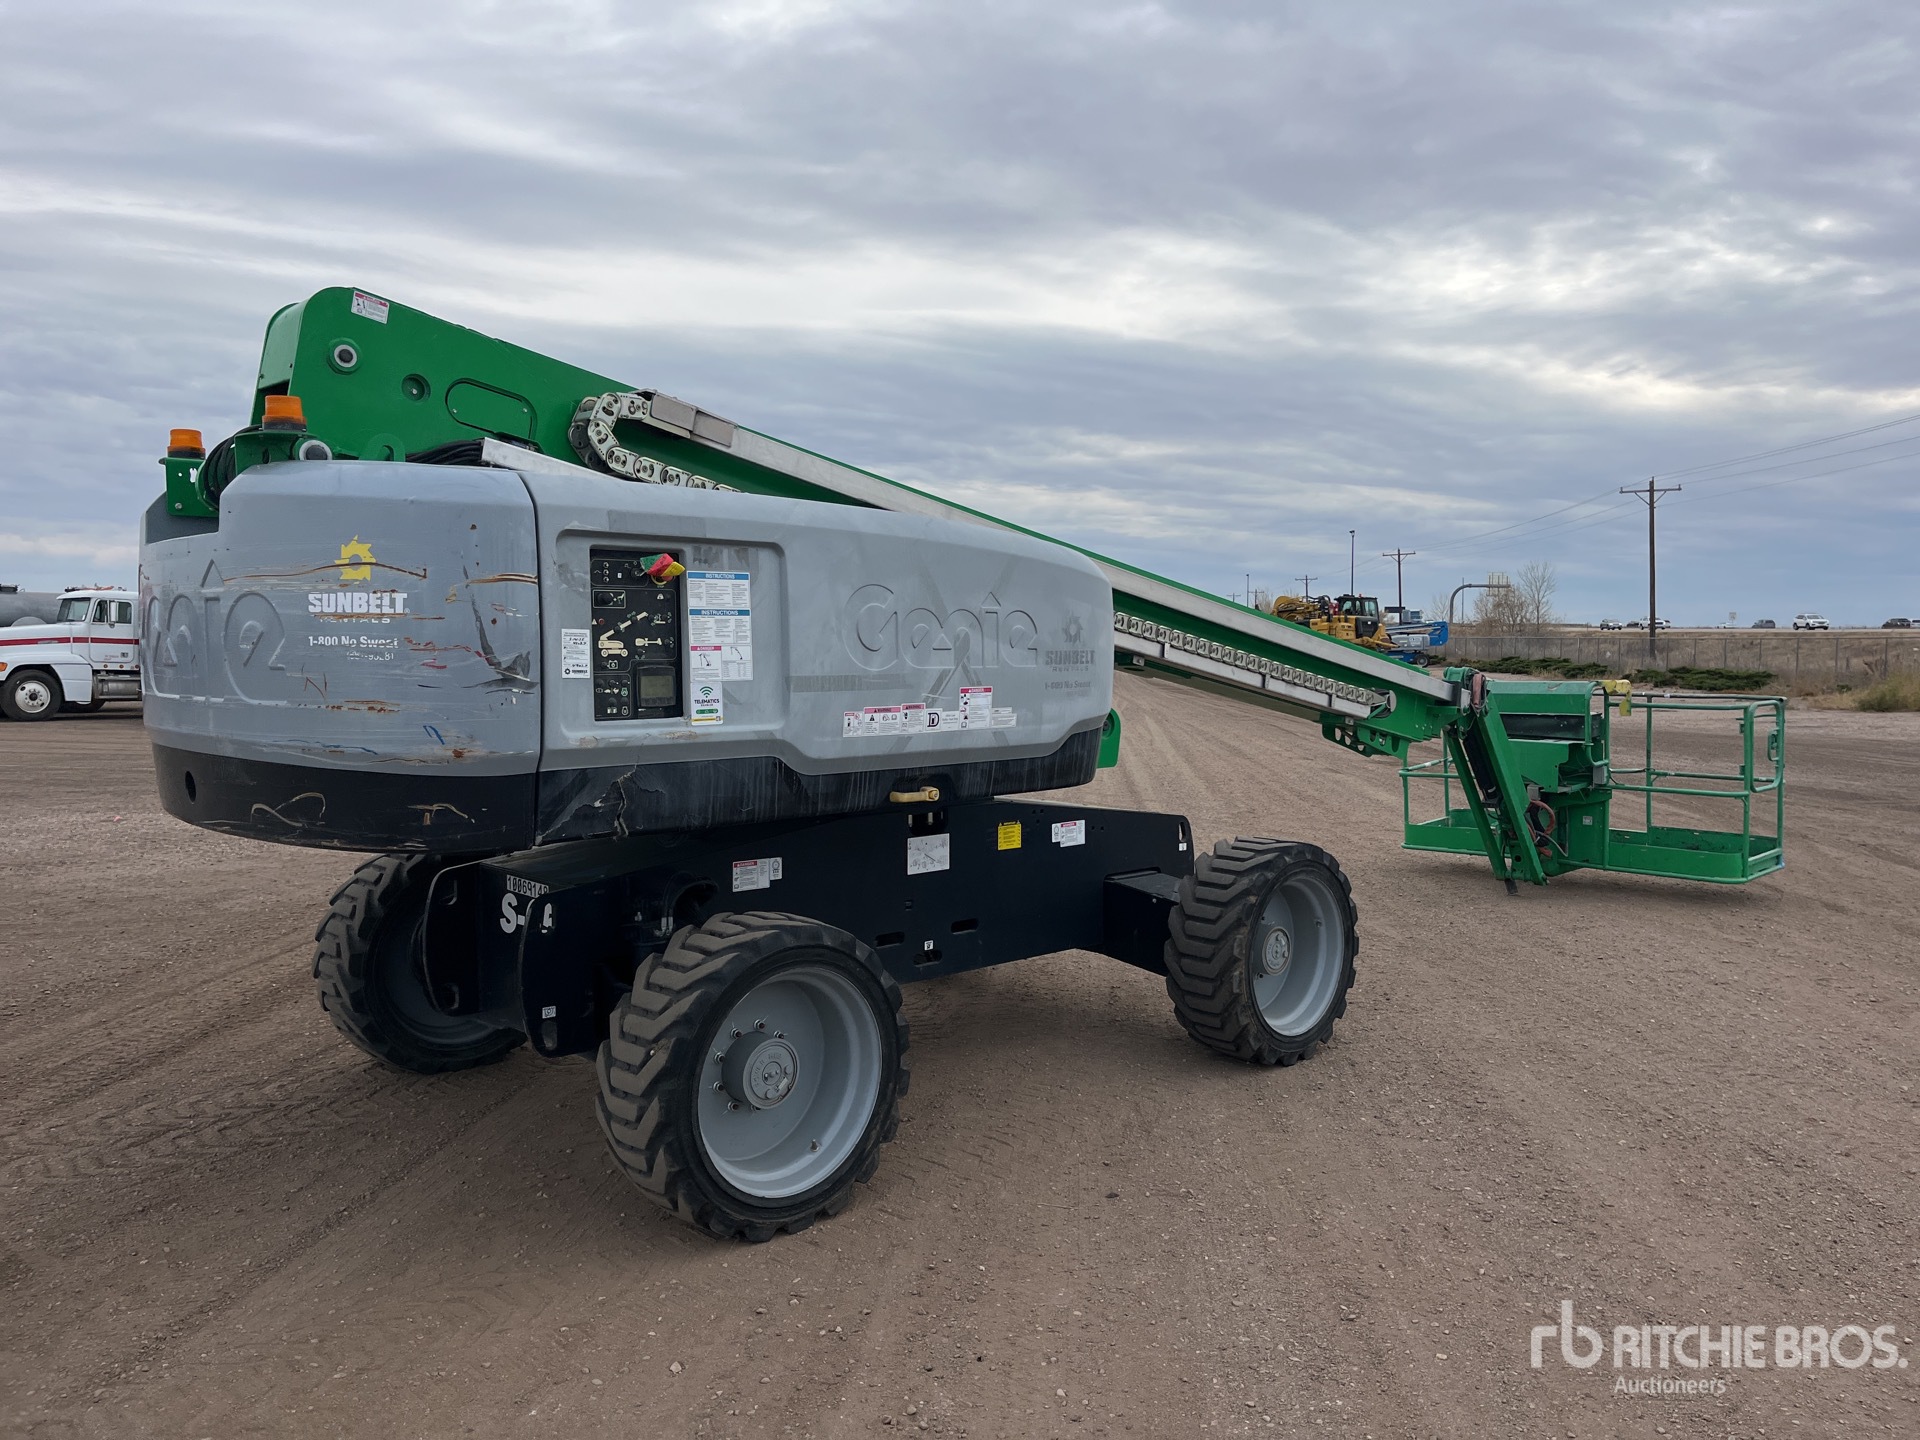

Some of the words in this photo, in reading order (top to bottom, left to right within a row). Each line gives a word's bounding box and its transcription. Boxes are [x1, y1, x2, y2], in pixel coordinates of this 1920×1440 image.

[308, 592, 408, 614] SUNBELT
[842, 583, 1038, 671] Genie
[308, 635, 338, 647] 1-800
[341, 635, 357, 648] No
